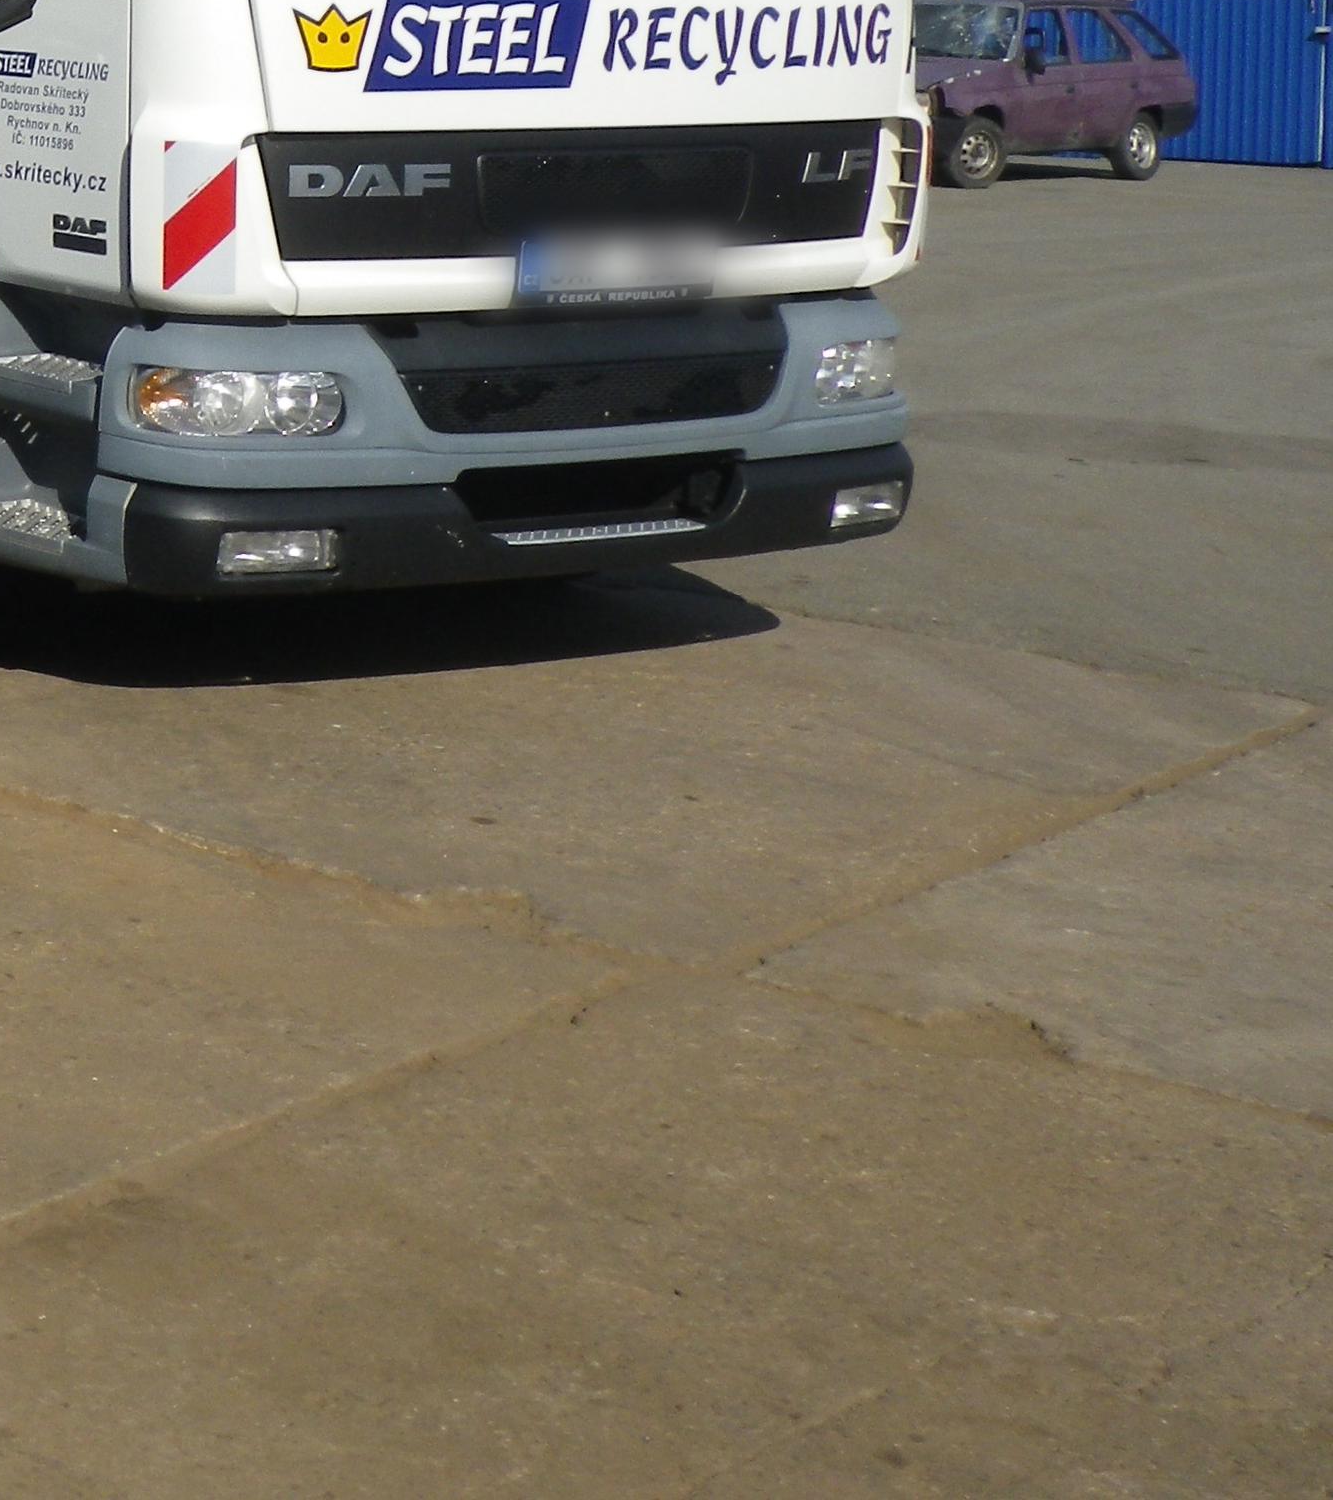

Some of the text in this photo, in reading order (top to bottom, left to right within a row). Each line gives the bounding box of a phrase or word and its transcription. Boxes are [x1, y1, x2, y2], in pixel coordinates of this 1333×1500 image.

[383, 1, 892, 86] STEEL RECYCLING
[37, 58, 109, 81] RECYCLING
[0, 98, 86, 118] Dobrovského 333
[7, 115, 50, 130] Rychnov
[802, 149, 873, 183] LF
[288, 163, 452, 198] DAF
[53, 213, 106, 235] DAF
[559, 290, 676, 304] ČESKÁ REPUBLIKA
